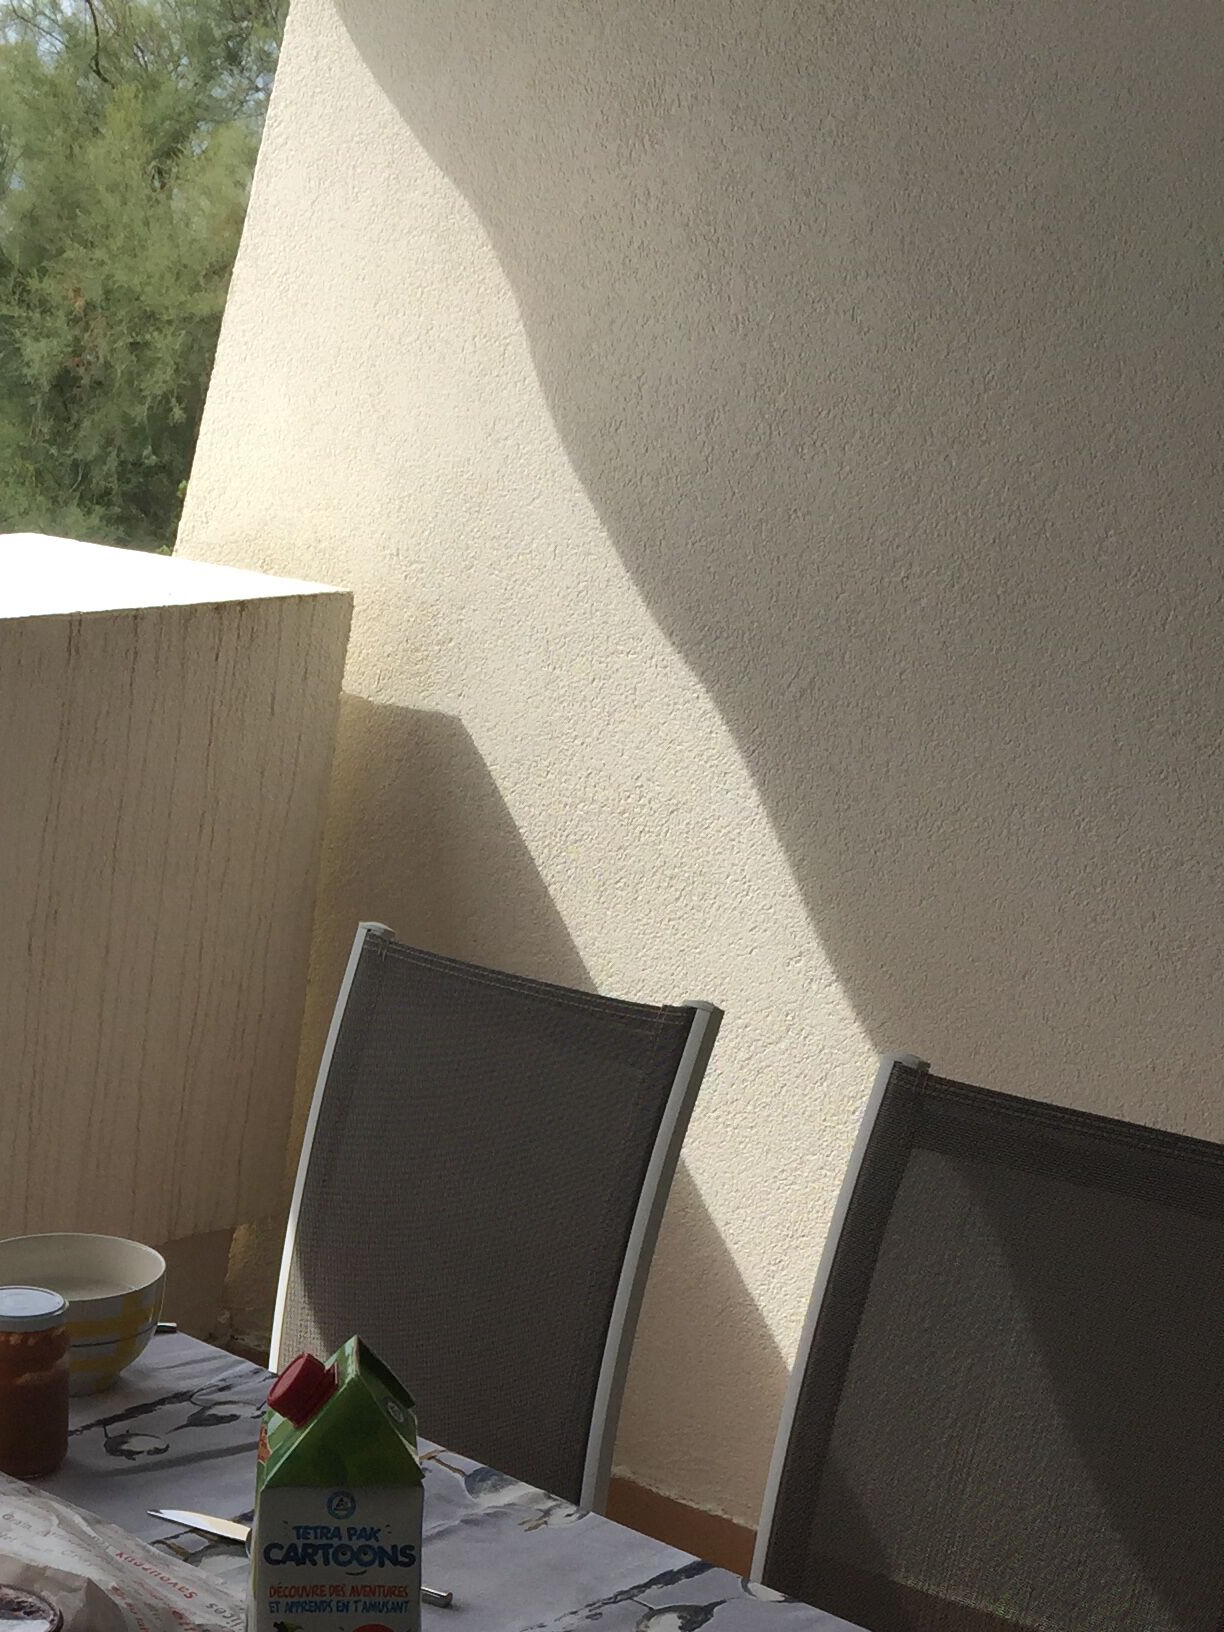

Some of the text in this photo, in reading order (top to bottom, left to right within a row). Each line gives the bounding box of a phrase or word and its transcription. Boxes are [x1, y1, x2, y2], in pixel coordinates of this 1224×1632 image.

[292, 1525, 382, 1543] TETRA PAK
[263, 1542, 417, 1568] CARTOONS
[269, 1582, 409, 1599] DÉCOUVRE DES AVENTURES
[269, 1600, 281, 1614] ET
[284, 1600, 334, 1614] APPRENDS
[336, 1600, 349, 1613] EN
